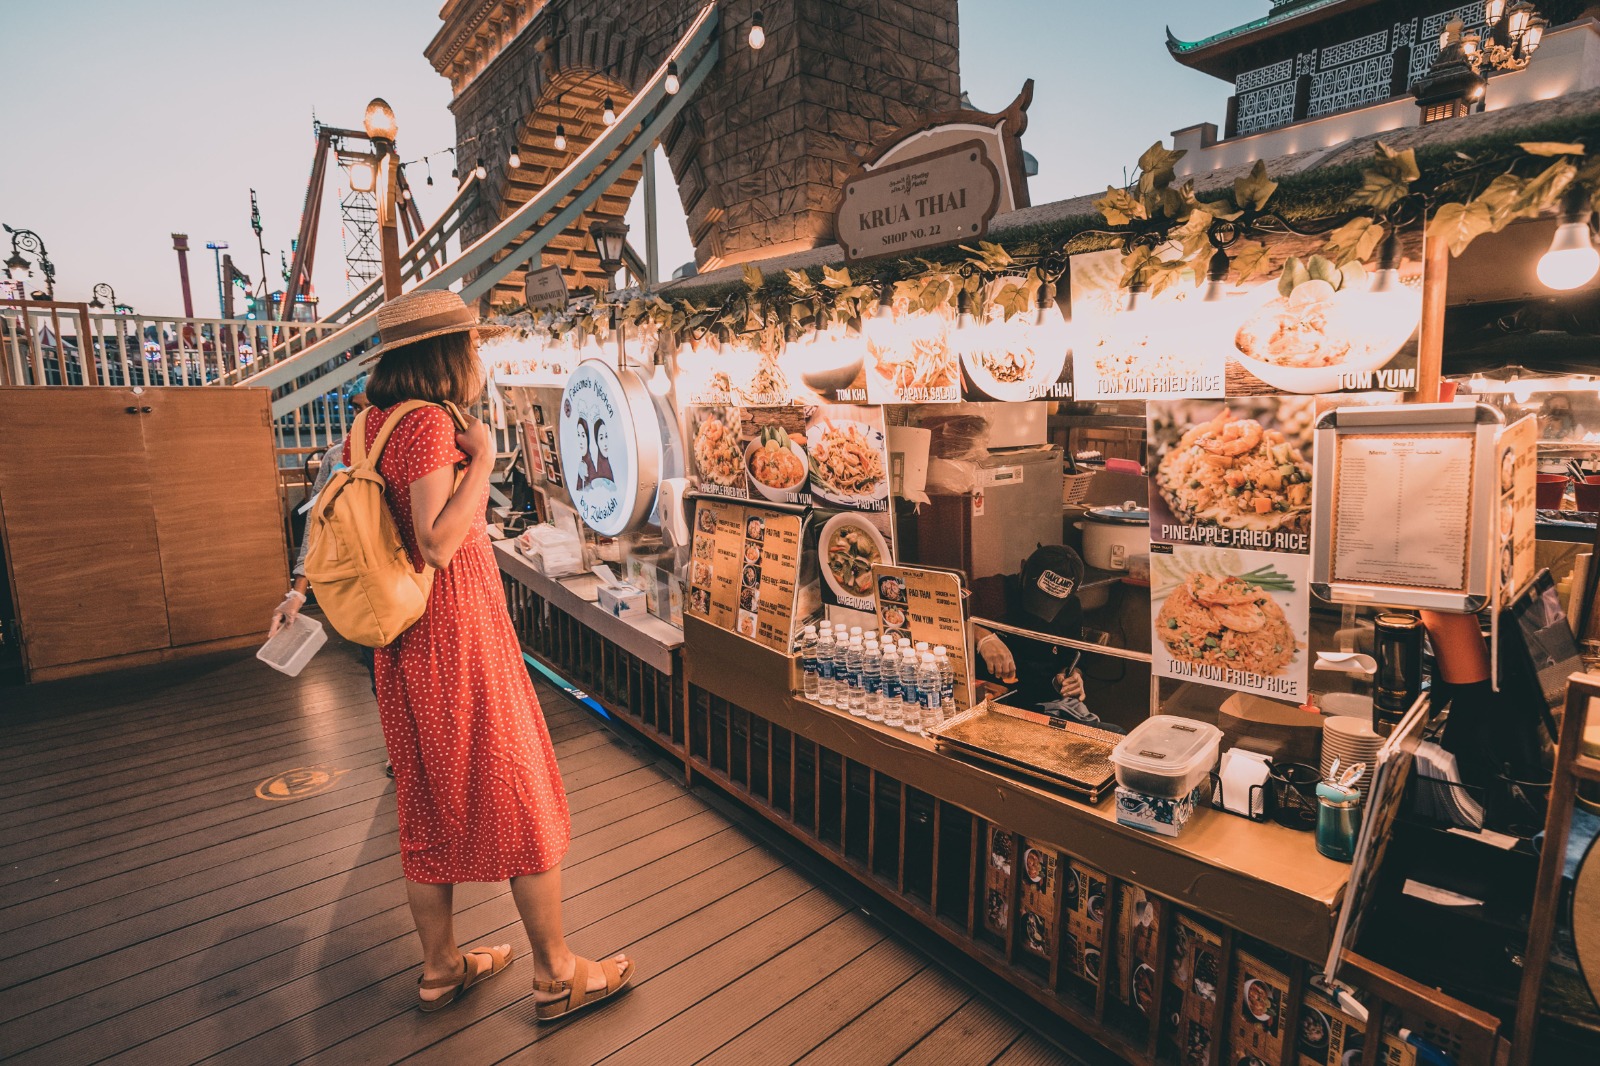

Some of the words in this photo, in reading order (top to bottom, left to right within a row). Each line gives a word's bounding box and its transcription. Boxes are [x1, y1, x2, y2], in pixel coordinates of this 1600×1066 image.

[859, 203, 910, 231] KRUA
[915, 188, 967, 217] THAI
[882, 231, 908, 245] SHOP
[909, 229, 927, 239] NO.
[929, 224, 941, 236] 22
[1097, 376, 1121, 394] TOM
[1124, 376, 1148, 393] YUM
[1152, 376, 1187, 392] FRIED
[1190, 375, 1220, 391] RICE
[1337, 371, 1374, 389] TOM
[1377, 368, 1415, 389] YUM
[594, 380, 614, 418] Kitchen
[836, 389, 851, 401] TOM
[852, 388, 866, 401] KHA
[899, 387, 928, 401] PAPAYA
[931, 385, 957, 400] SALAD
[1028, 384, 1046, 399] PAD
[1049, 382, 1073, 398] THAI
[701, 483, 724, 495] PINEAPPLE
[724, 486, 736, 497] FRIED
[736, 487, 747, 499] RICE
[785, 492, 798, 502] TOM
[799, 493, 811, 504] YUM
[580, 495, 588, 519] by
[857, 499, 870, 510] PAD
[871, 499, 887, 512] THAI
[1161, 524, 1230, 544] PINEAPPLE
[1232, 529, 1271, 547] FRIED
[1275, 533, 1308, 550] RICE
[1045, 571, 1071, 588] OAKLAND
[908, 588, 919, 597] PAD
[919, 589, 931, 599] THAI
[911, 613, 922, 622] TOM
[922, 615, 934, 624] YUM
[1167, 659, 1193, 677] TOM
[1195, 663, 1223, 682] YUM
[1225, 668, 1263, 689] FRIED
[1267, 675, 1298, 696] RICE
[1122, 798, 1135, 807] fine
[1332, 1018, 1342, 1038] FRIED
[1331, 1037, 1340, 1053] RICE
[1390, 1047, 1402, 1062] PAD
